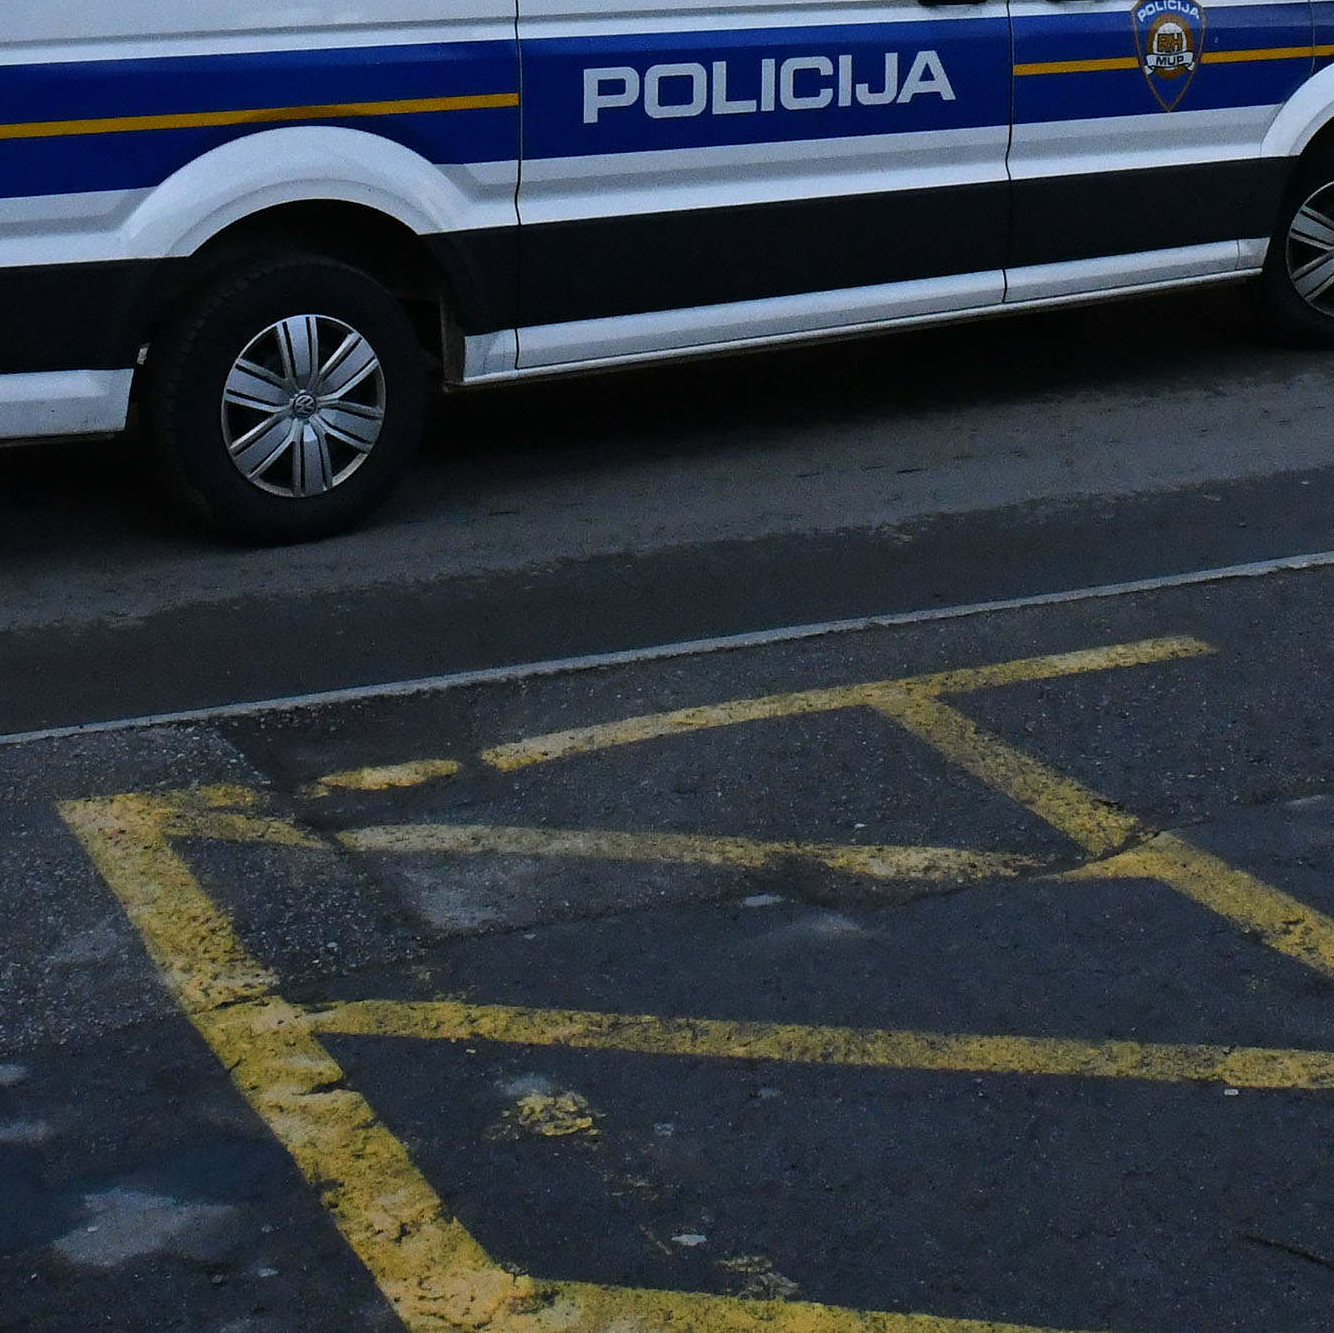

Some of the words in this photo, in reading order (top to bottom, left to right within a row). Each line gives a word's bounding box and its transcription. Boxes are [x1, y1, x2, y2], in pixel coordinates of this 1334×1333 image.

[1137, 0, 1200, 23] POLICIJA
[1157, 32, 1183, 53] RH
[1156, 55, 1184, 66] MUP
[583, 50, 957, 124] POLICIJA
